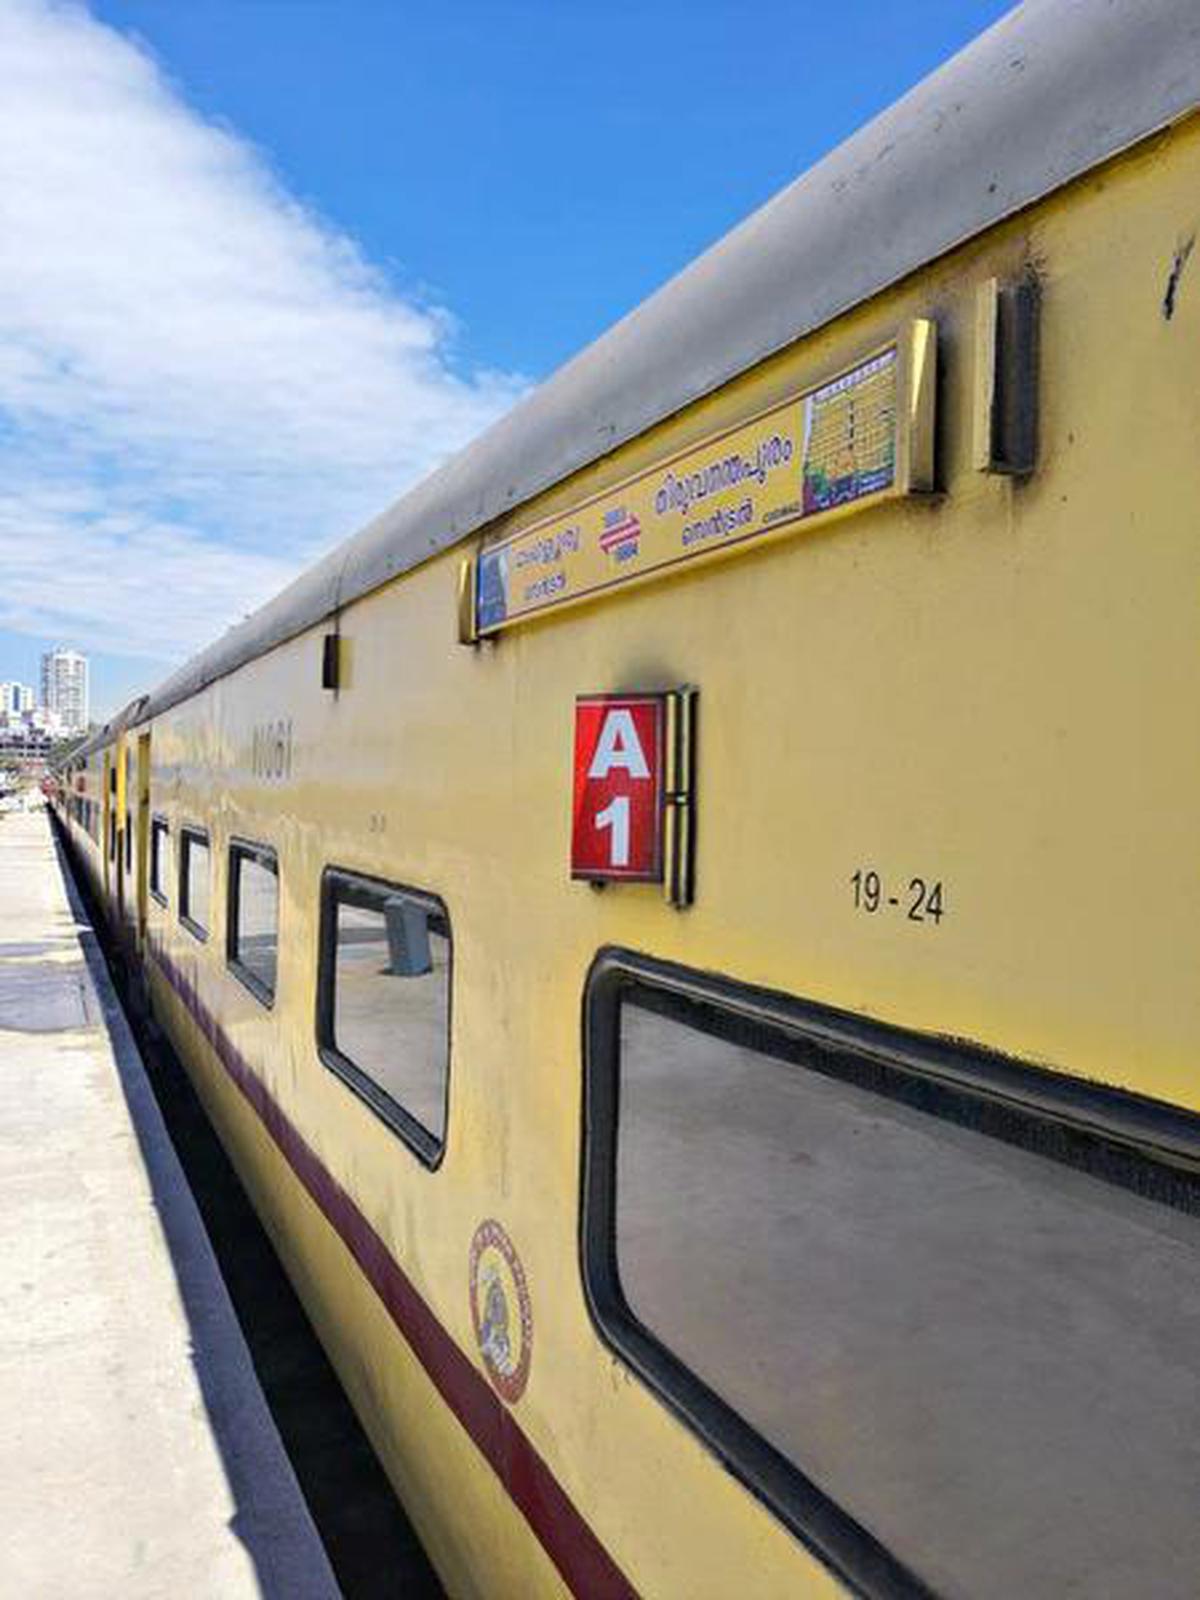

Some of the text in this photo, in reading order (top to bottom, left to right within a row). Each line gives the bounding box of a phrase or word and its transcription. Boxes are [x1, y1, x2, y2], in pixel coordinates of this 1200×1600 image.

[587, 709, 651, 779] A
[595, 796, 631, 867] 1
[851, 869, 880, 912] 19
[908, 877, 944, 925] 24
